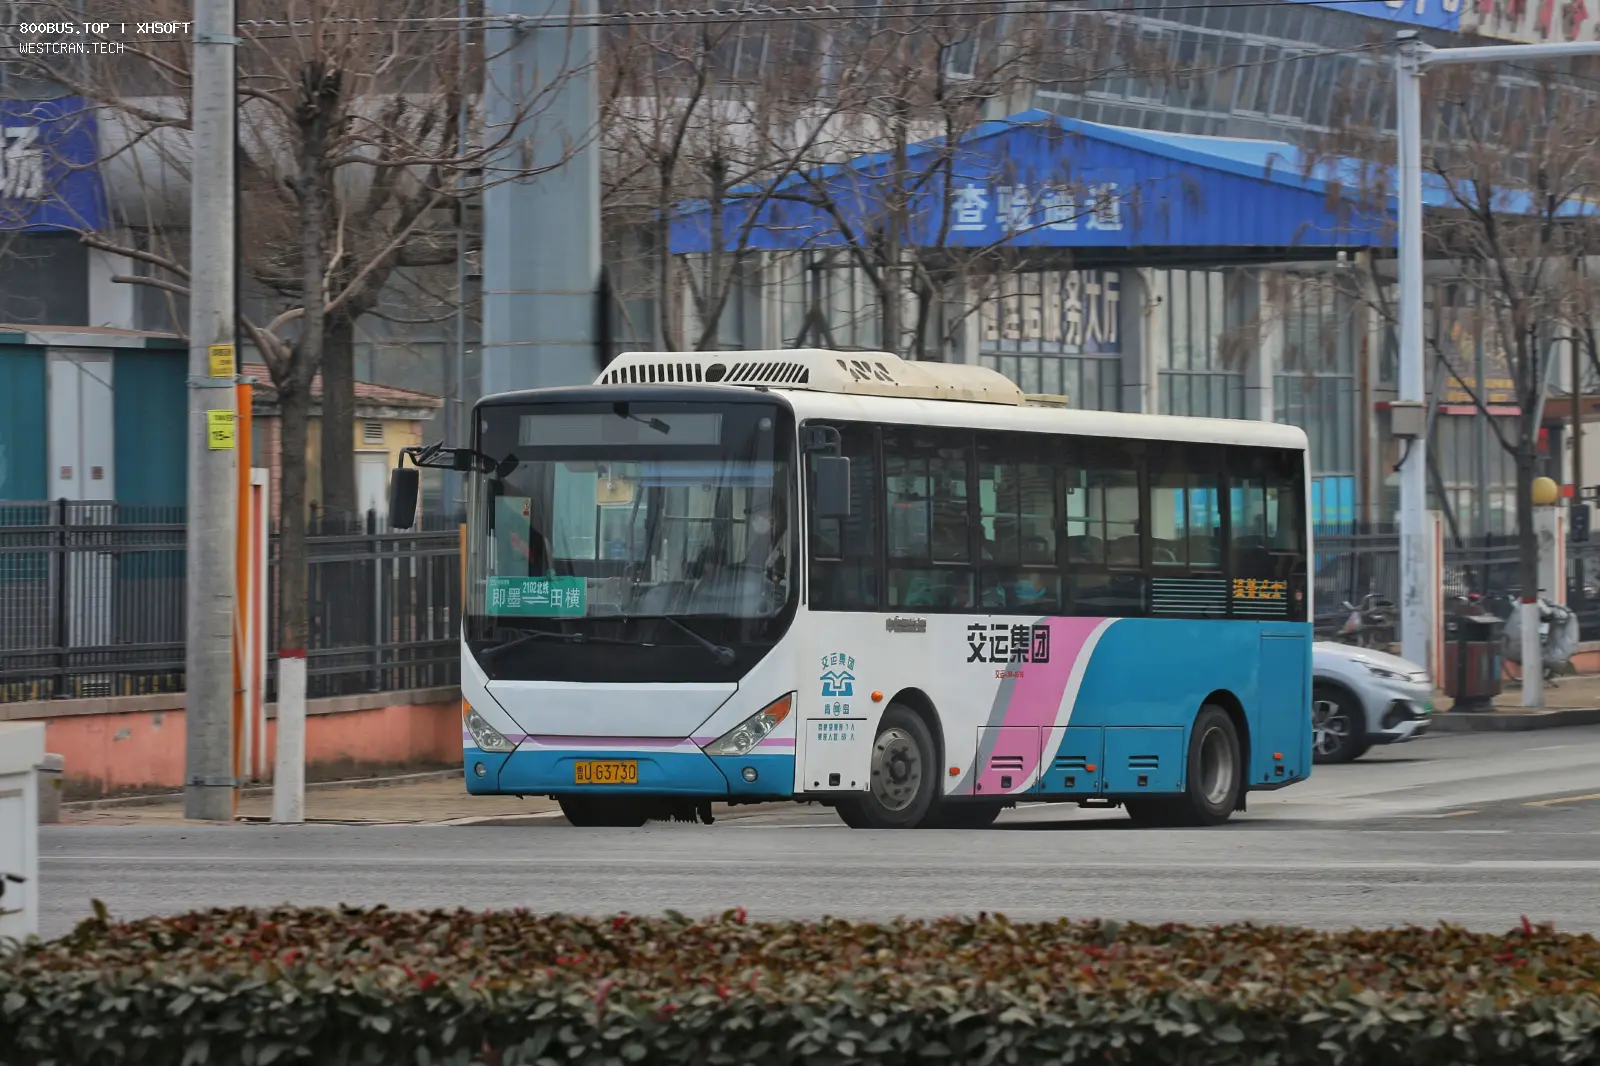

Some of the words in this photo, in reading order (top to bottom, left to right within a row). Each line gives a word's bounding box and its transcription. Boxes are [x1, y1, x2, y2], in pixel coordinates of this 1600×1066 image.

[951, 183, 1123, 231] 查验通道
[492, 588, 521, 608] 即墨
[550, 587, 580, 609] 田横
[967, 623, 1050, 664] 交运集团
[821, 652, 855, 671] 交运集团
